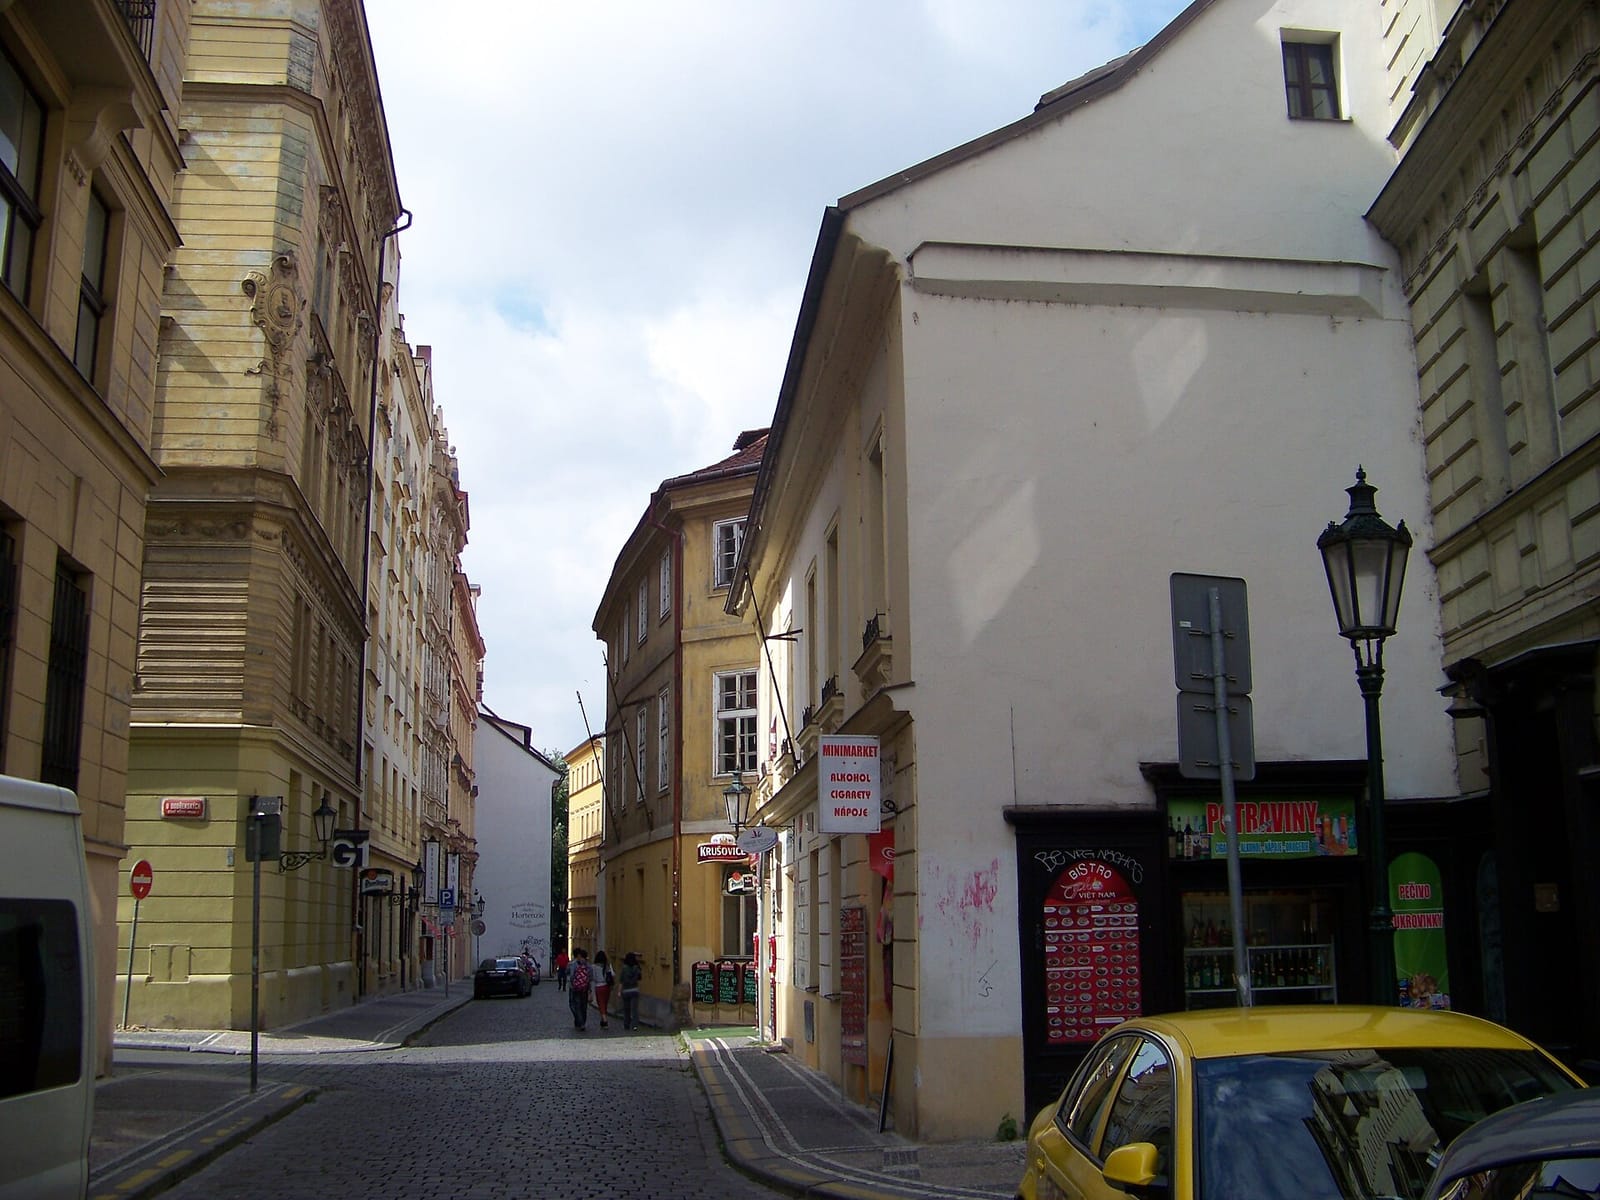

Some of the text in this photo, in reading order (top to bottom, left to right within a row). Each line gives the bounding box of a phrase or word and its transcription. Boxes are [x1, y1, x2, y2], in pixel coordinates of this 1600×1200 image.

[822, 744, 878, 757] MINIMARKET
[830, 773, 871, 782] ALKOHOL
[830, 790, 871, 800] CIGARETY
[834, 806, 868, 817] NÁPOJE
[1068, 862, 1112, 880] BISTRO
[1398, 881, 1431, 900] PEČIVO
[442, 891, 451, 904] P
